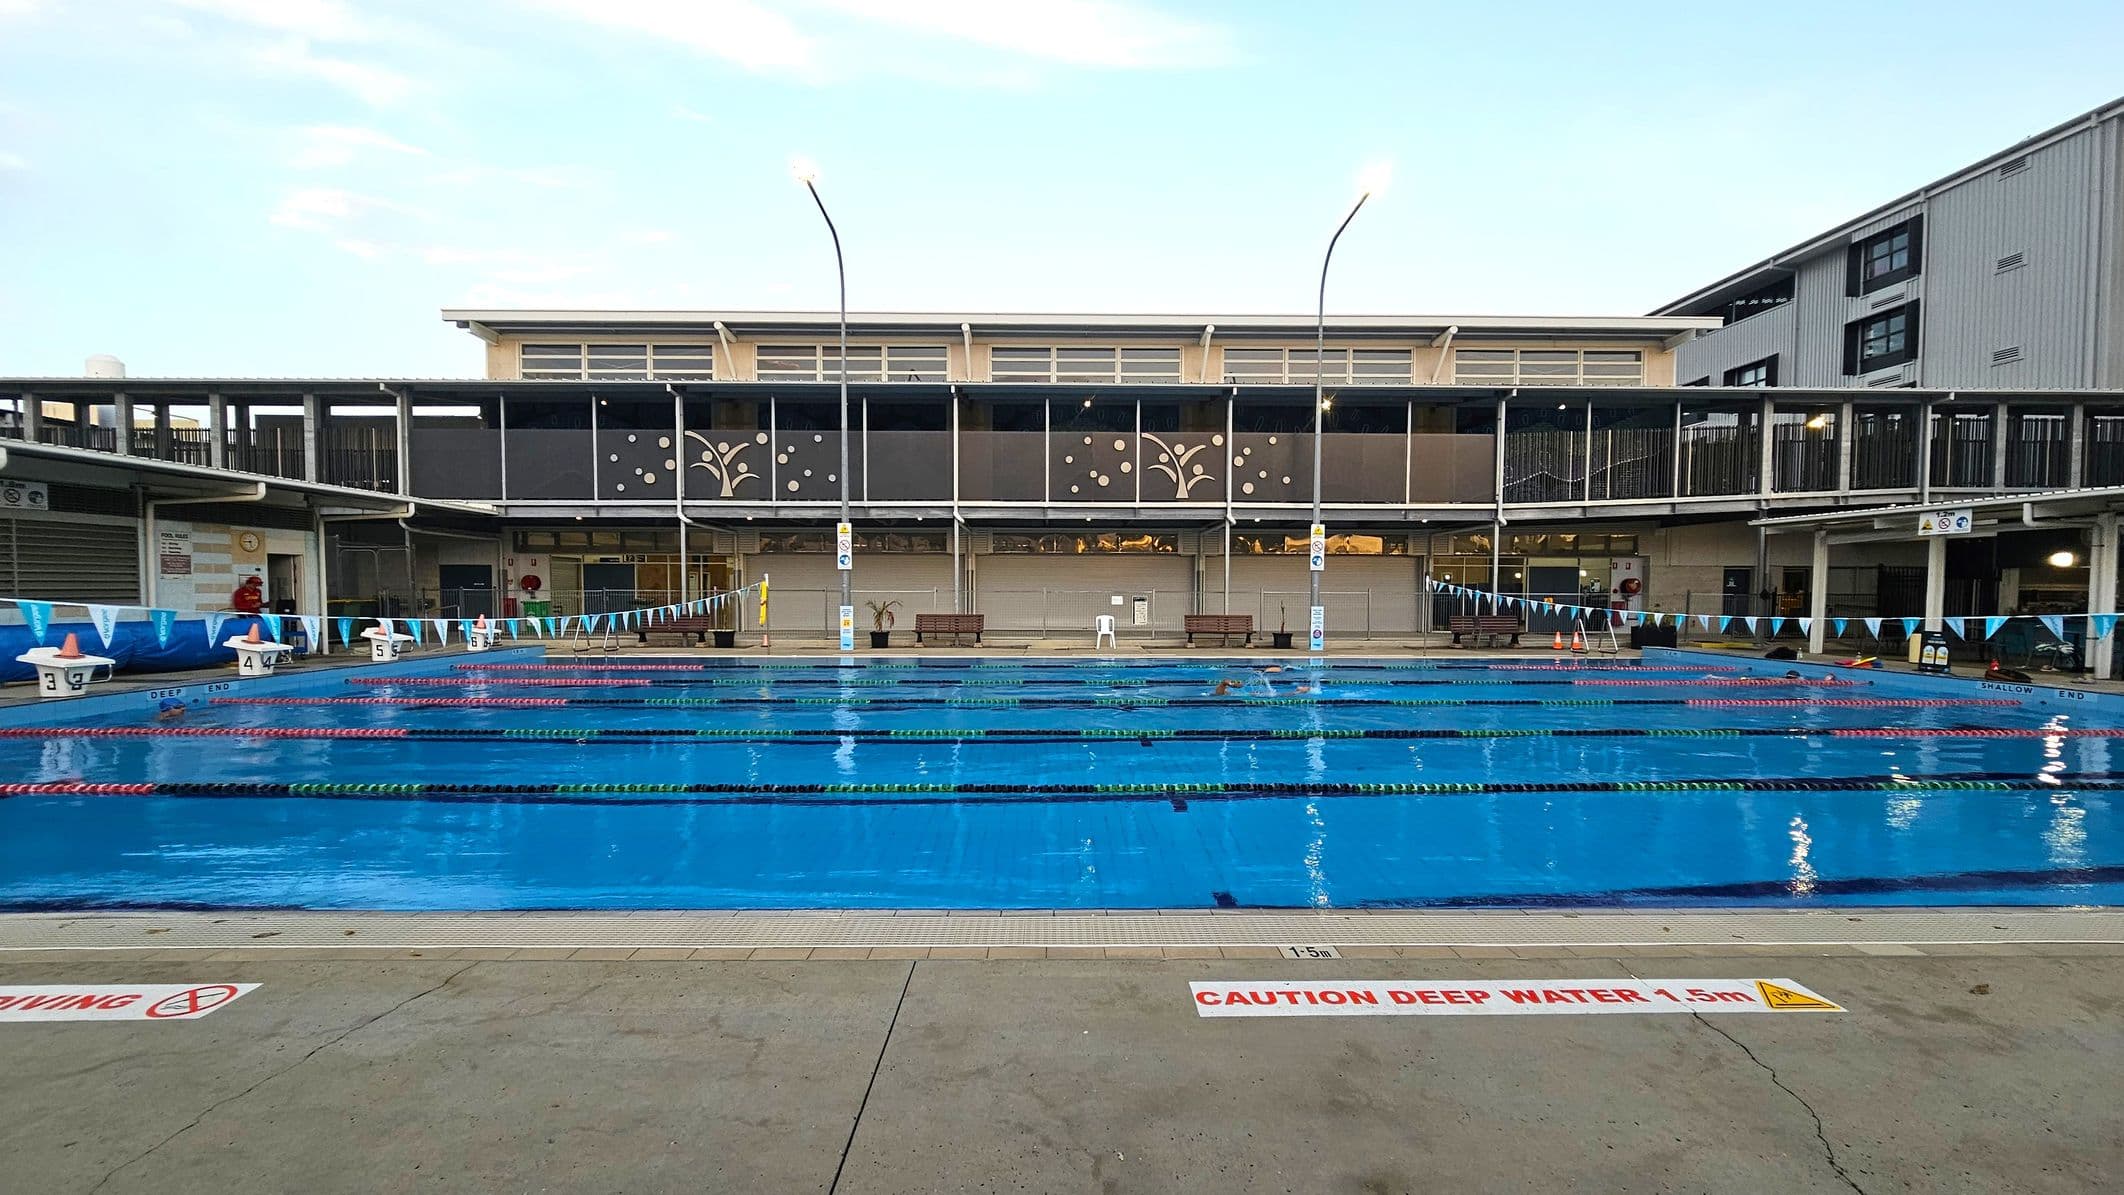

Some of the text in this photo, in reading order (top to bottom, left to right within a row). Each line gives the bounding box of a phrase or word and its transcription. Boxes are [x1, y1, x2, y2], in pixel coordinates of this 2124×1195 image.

[471, 637, 477, 647] 6
[376, 645, 384, 656] 5
[243, 655, 253, 670] 4
[262, 655, 272, 670] 4
[44, 673, 56, 690] 3
[71, 673, 83, 690] 3
[150, 683, 230, 699] DEEP END
[1981, 682, 2085, 700] SHALLOW END
[1195, 988, 1756, 1006] CAUTION DEEP WATER 1.5m
